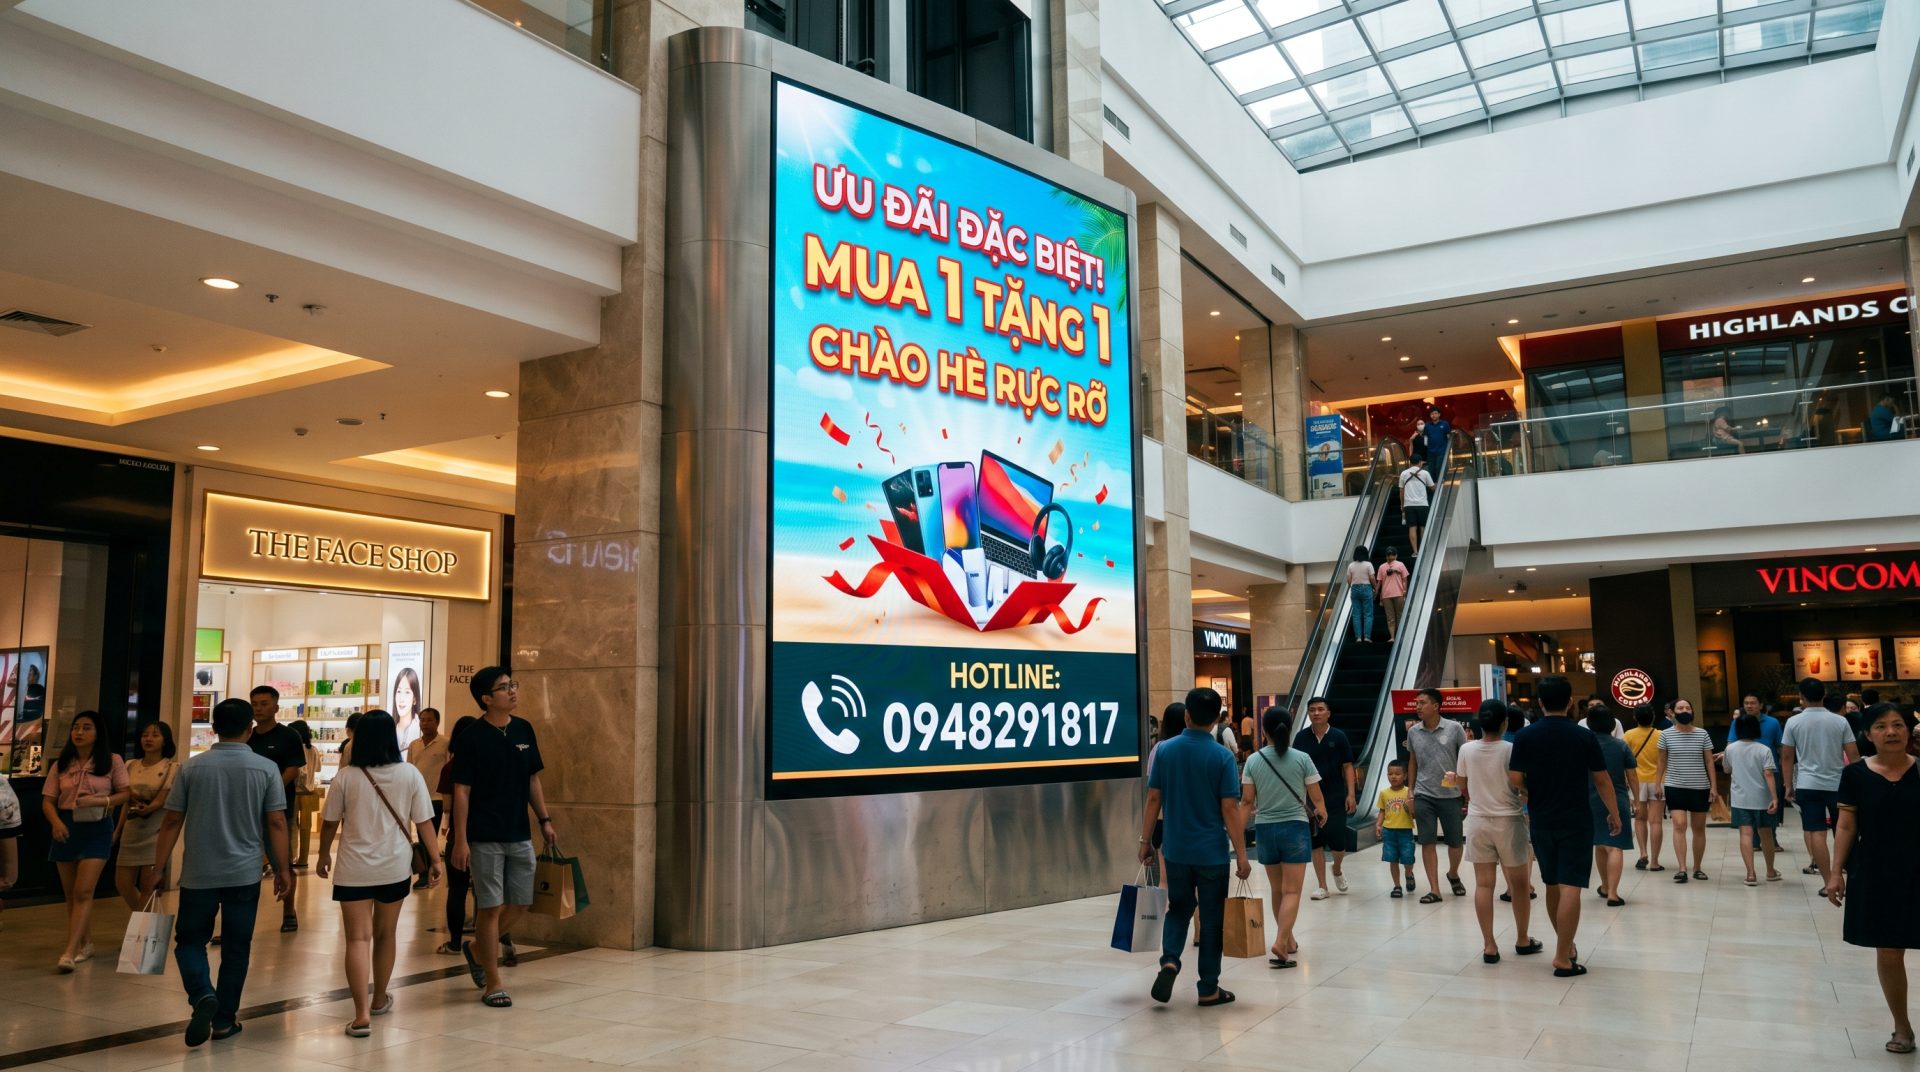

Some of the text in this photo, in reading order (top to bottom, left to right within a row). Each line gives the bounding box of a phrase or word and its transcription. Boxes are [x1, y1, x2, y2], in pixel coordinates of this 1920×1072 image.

[813, 163, 1105, 291] ƯU ĐÃI ĐẶC BIỆT!
[804, 233, 1112, 364] MUA 1 TẶNG 1
[1689, 301, 1880, 340] HIGHLANDS
[810, 324, 1109, 426] CHÀO HÈ RỰC RỠ
[248, 528, 458, 575] THE FACE SHOP
[1756, 561, 1920, 594] VINCOM
[1204, 630, 1237, 650] VINCOM
[457, 664, 475, 674] THE
[950, 662, 1061, 690] HOTLINE:
[882, 702, 1119, 752] 0948291817
